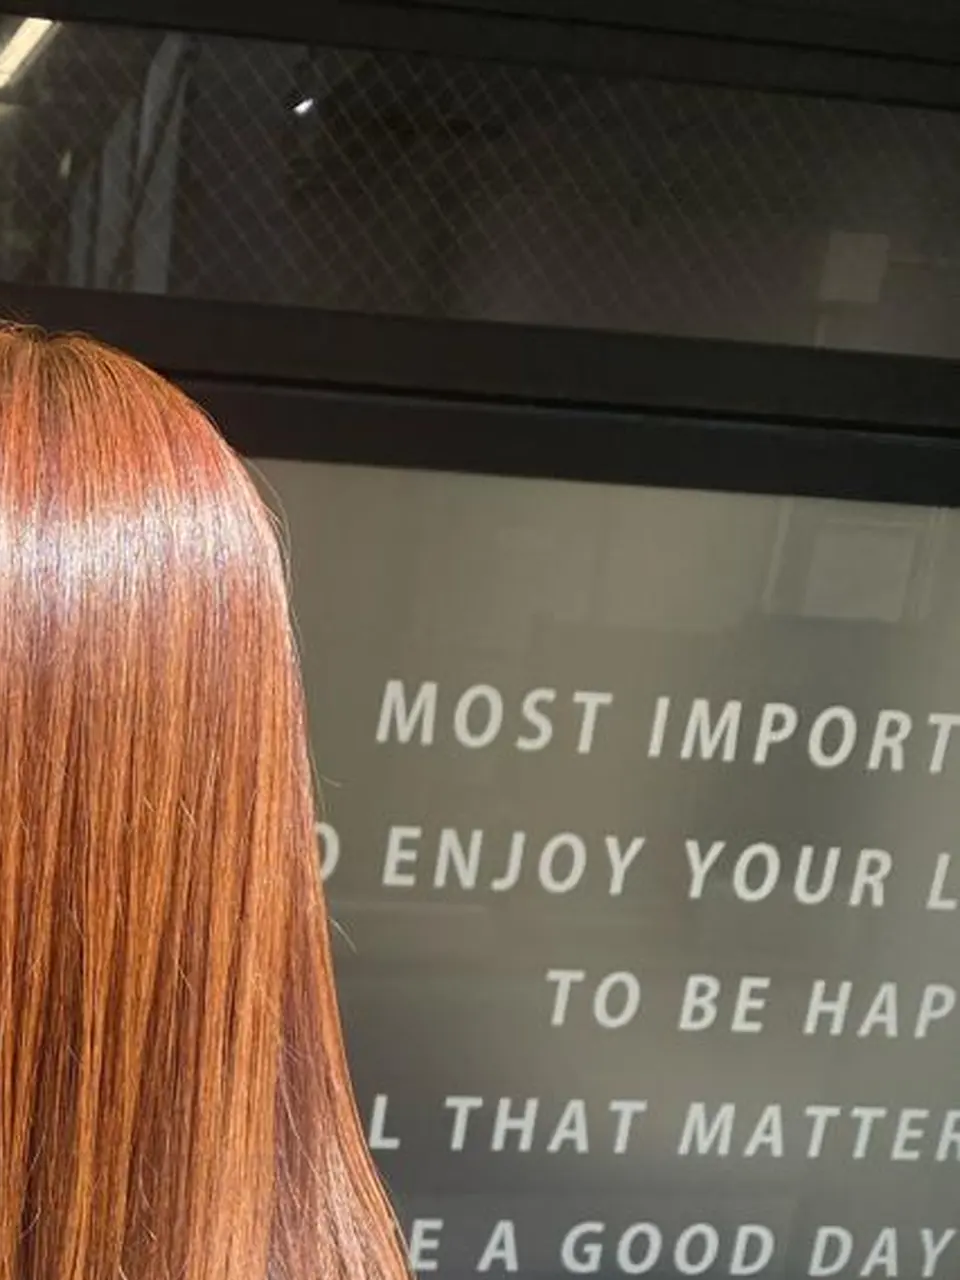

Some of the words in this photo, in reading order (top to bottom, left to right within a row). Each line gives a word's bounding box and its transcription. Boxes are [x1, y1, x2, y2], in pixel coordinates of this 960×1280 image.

[375, 680, 613, 754] MOST
[647, 697, 960, 773] IMPORT
[382, 826, 645, 896] ENJOY
[685, 839, 893, 907] YOUR
[926, 852, 957, 910] L
[545, 969, 641, 1028] TO
[678, 975, 770, 1034] BE
[803, 980, 956, 1038] HAP
[369, 1094, 401, 1149] L
[445, 1096, 647, 1154] THAT
[410, 1218, 444, 1271] E
[476, 1219, 519, 1272] A
[561, 1221, 775, 1275] GOOD
[808, 1225, 957, 1278] DAY
